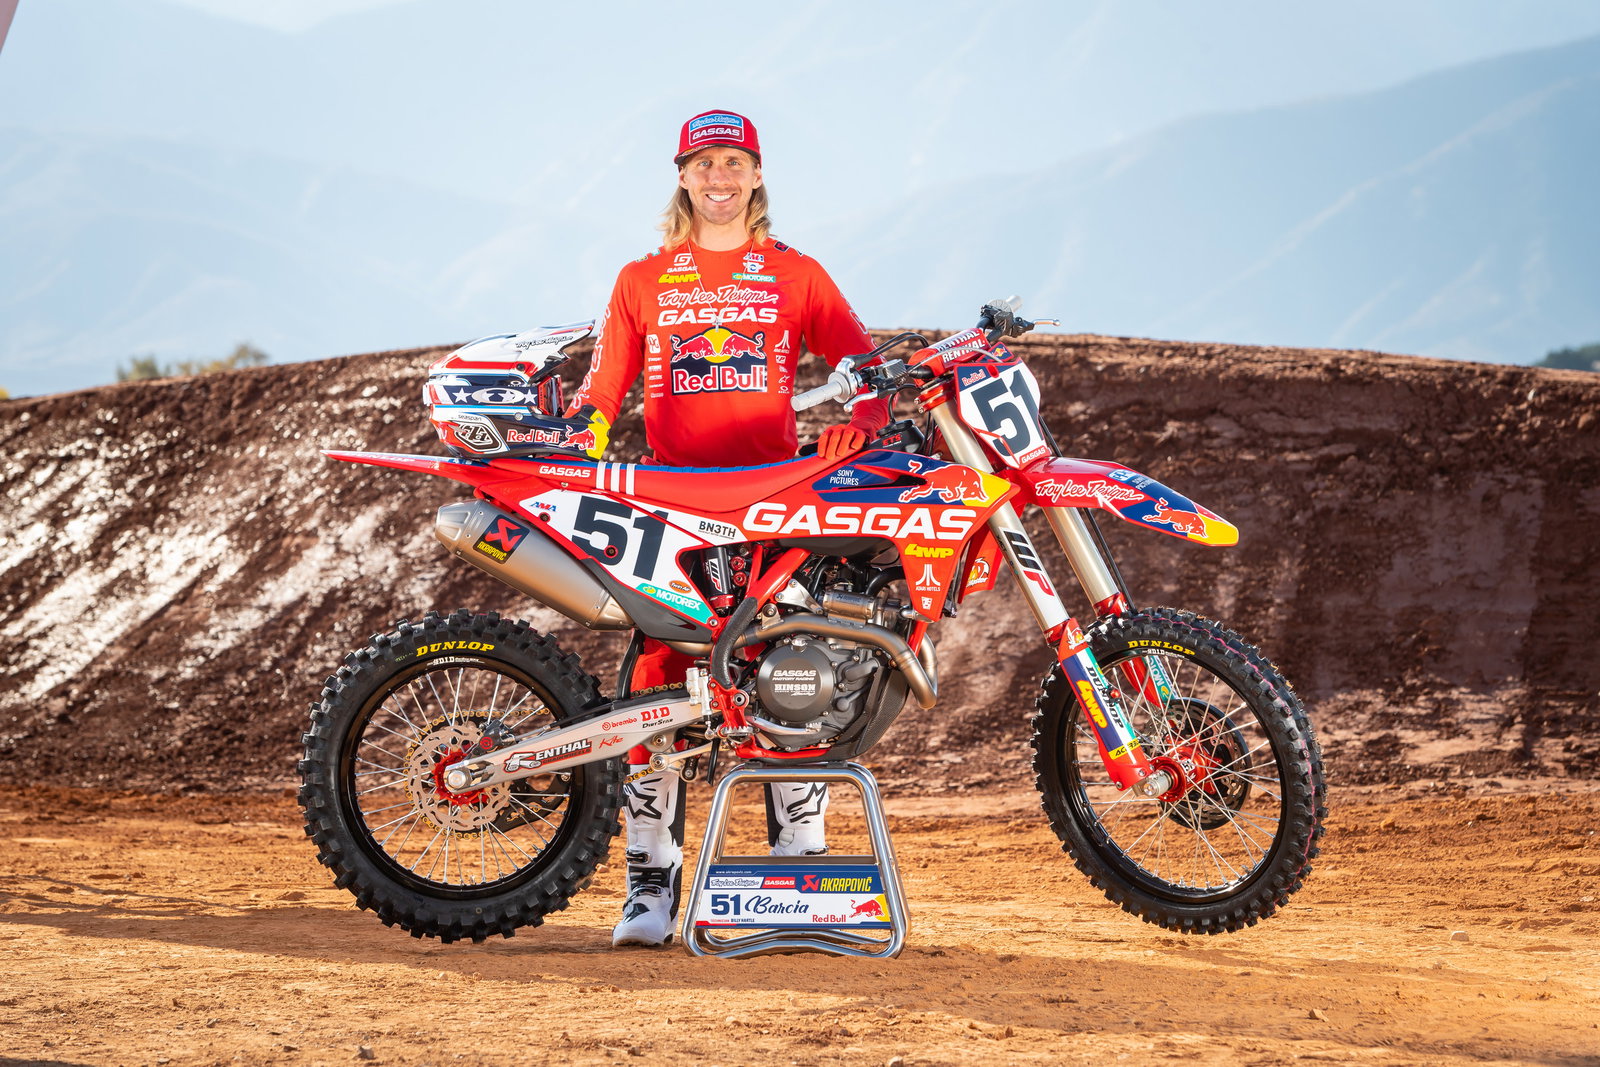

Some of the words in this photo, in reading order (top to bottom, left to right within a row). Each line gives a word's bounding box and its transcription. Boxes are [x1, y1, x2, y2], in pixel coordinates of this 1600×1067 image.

[692, 127, 740, 140] GASGAS
[657, 288, 690, 308] Troy
[688, 287, 717, 304] Lee
[716, 284, 779, 306] Designs
[657, 306, 779, 327] GASGAS
[672, 365, 720, 394] Red
[720, 364, 766, 390] Bull
[970, 369, 1044, 457] 51
[507, 429, 534, 443] Red
[535, 430, 559, 444] Bull
[882, 433, 902, 446] ETS
[1021, 446, 1046, 464] GASGAS
[539, 465, 591, 478] GASGAS
[837, 469, 855, 477] SONY
[829, 476, 860, 486] PICTURES
[1035, 478, 1061, 502] Troy
[1060, 480, 1086, 497] Lee
[1086, 479, 1144, 501] Designs
[529, 501, 557, 513] AMA
[698, 520, 737, 538] BN3TH
[742, 502, 977, 541] GASGAS
[571, 495, 669, 582] 51
[656, 589, 702, 611] MOTOREX
[416, 640, 495, 657] DUNLOP
[1127, 639, 1196, 656] DUNLOP
[773, 669, 817, 677] GASGAS
[774, 683, 816, 691] HINSON
[611, 717, 638, 728] brembo
[711, 893, 741, 916] 51
[744, 895, 809, 915] Barcia
[812, 914, 829, 923] Red
[830, 914, 847, 923] Bull
